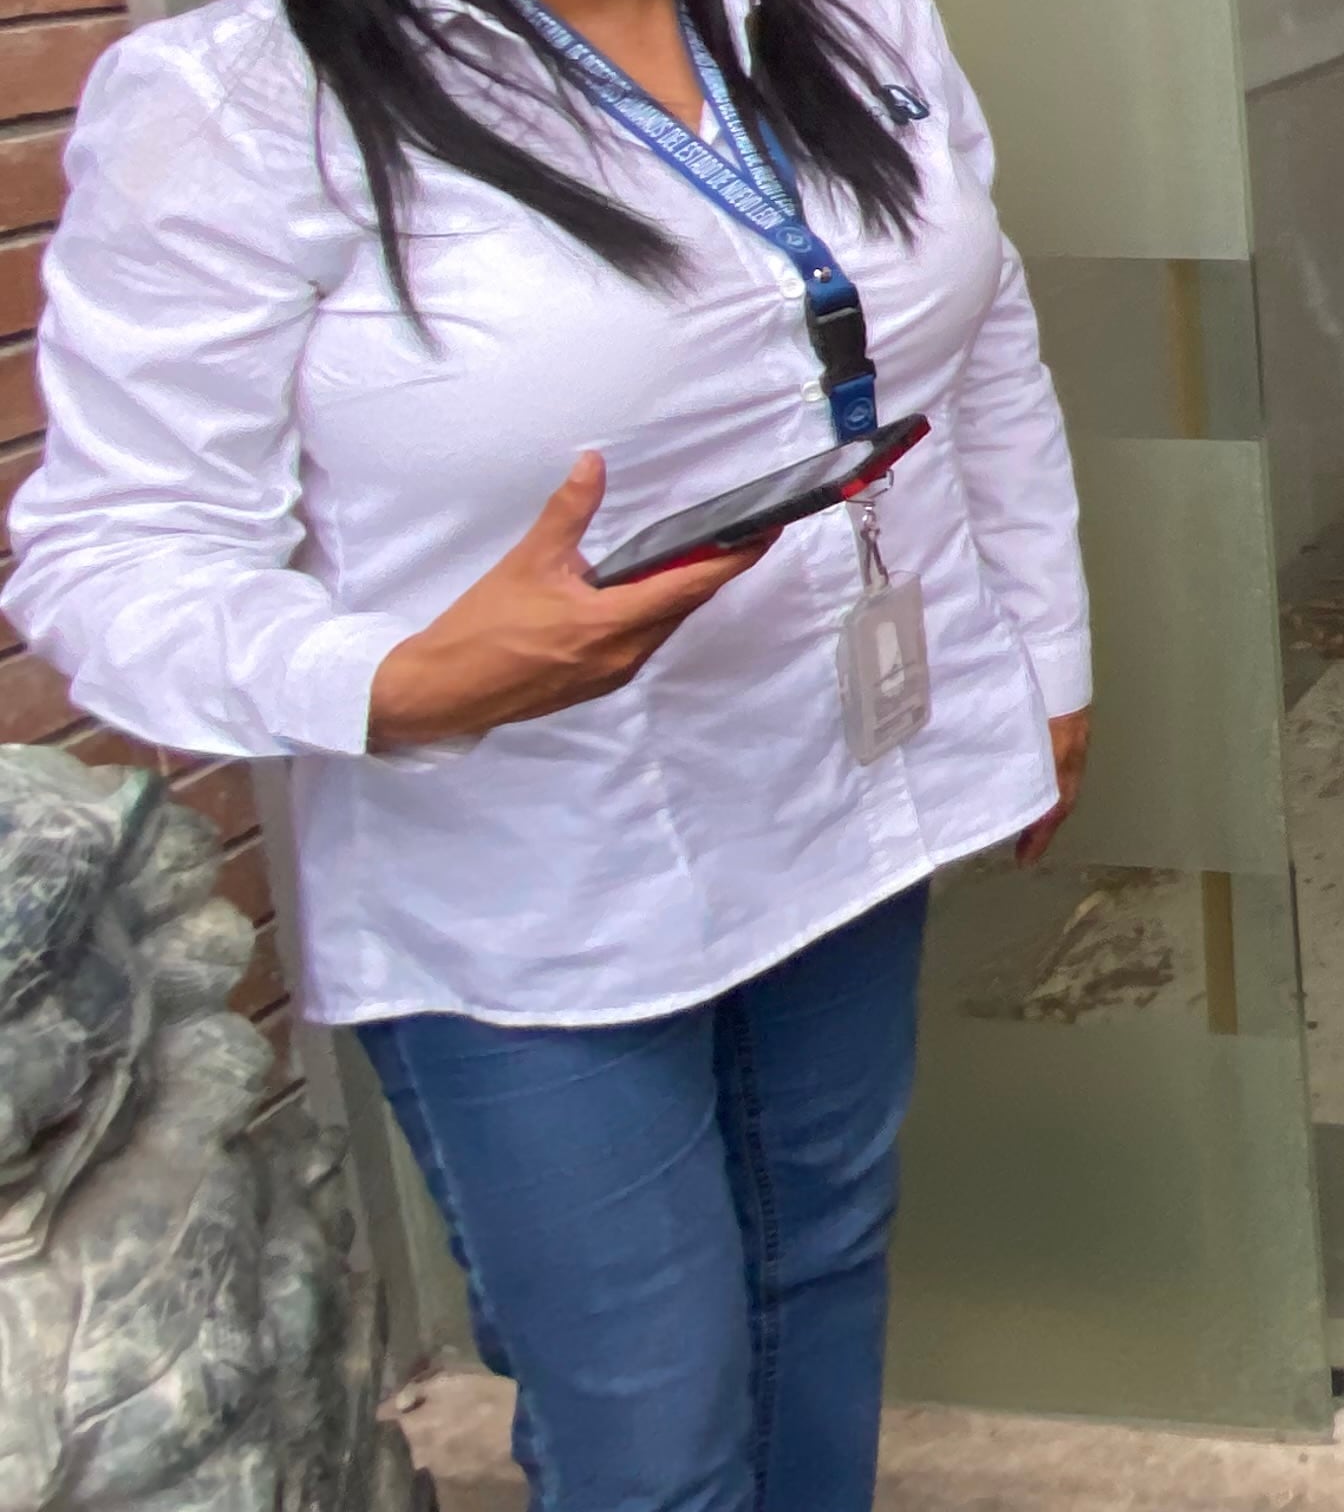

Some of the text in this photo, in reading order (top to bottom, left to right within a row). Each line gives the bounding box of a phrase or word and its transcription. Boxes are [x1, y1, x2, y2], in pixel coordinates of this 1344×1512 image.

[656, 127, 691, 153] DEL
[673, 141, 724, 180] ESTADO
[706, 168, 738, 191] DE
[719, 178, 763, 213] NUEVO
